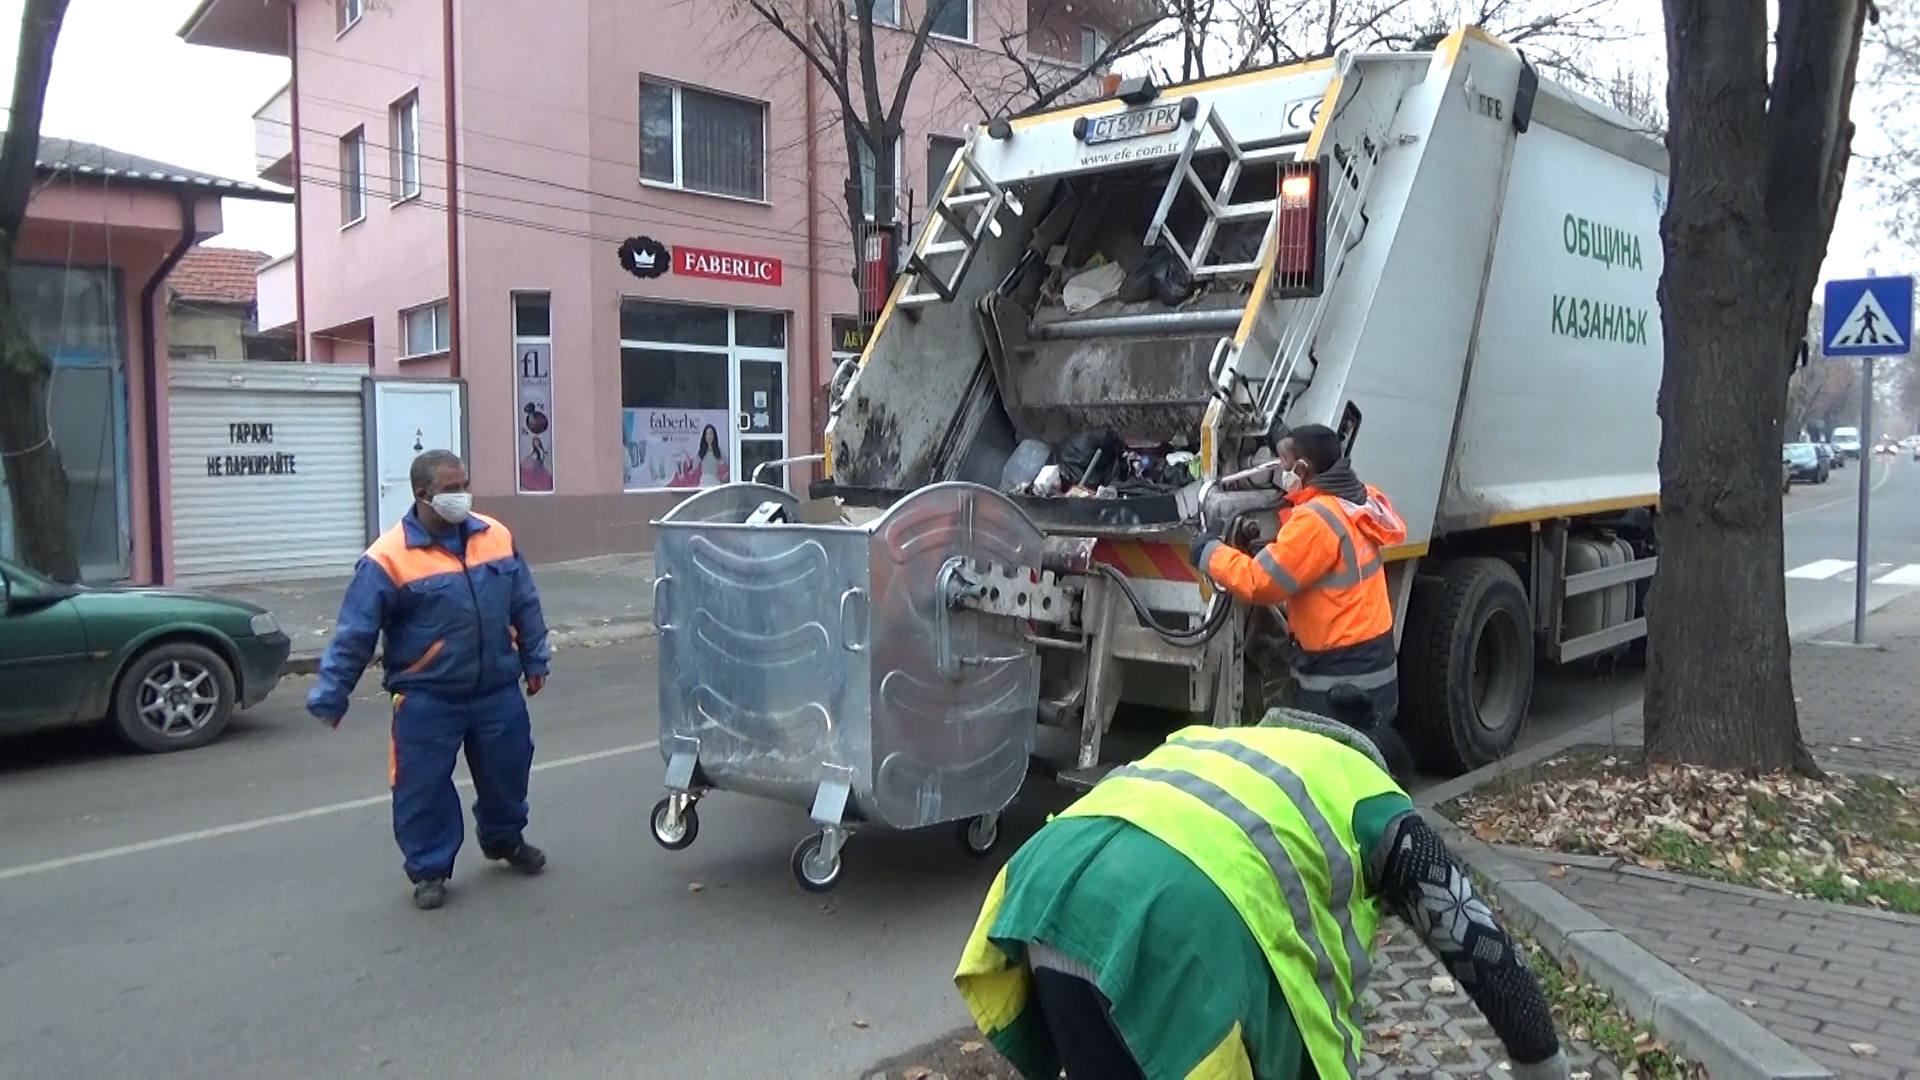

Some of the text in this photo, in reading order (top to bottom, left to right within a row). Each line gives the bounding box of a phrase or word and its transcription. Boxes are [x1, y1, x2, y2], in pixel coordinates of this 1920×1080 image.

[1080, 142, 1180, 166] www.efe.com.tr
[1563, 213, 1643, 271] ОБЩИНА
[684, 252, 773, 280] FABERLIC
[1551, 294, 1648, 345] КАЗАНЛЪК
[207, 451, 297, 477] НЕ ПАРКИРАЙТЕ
